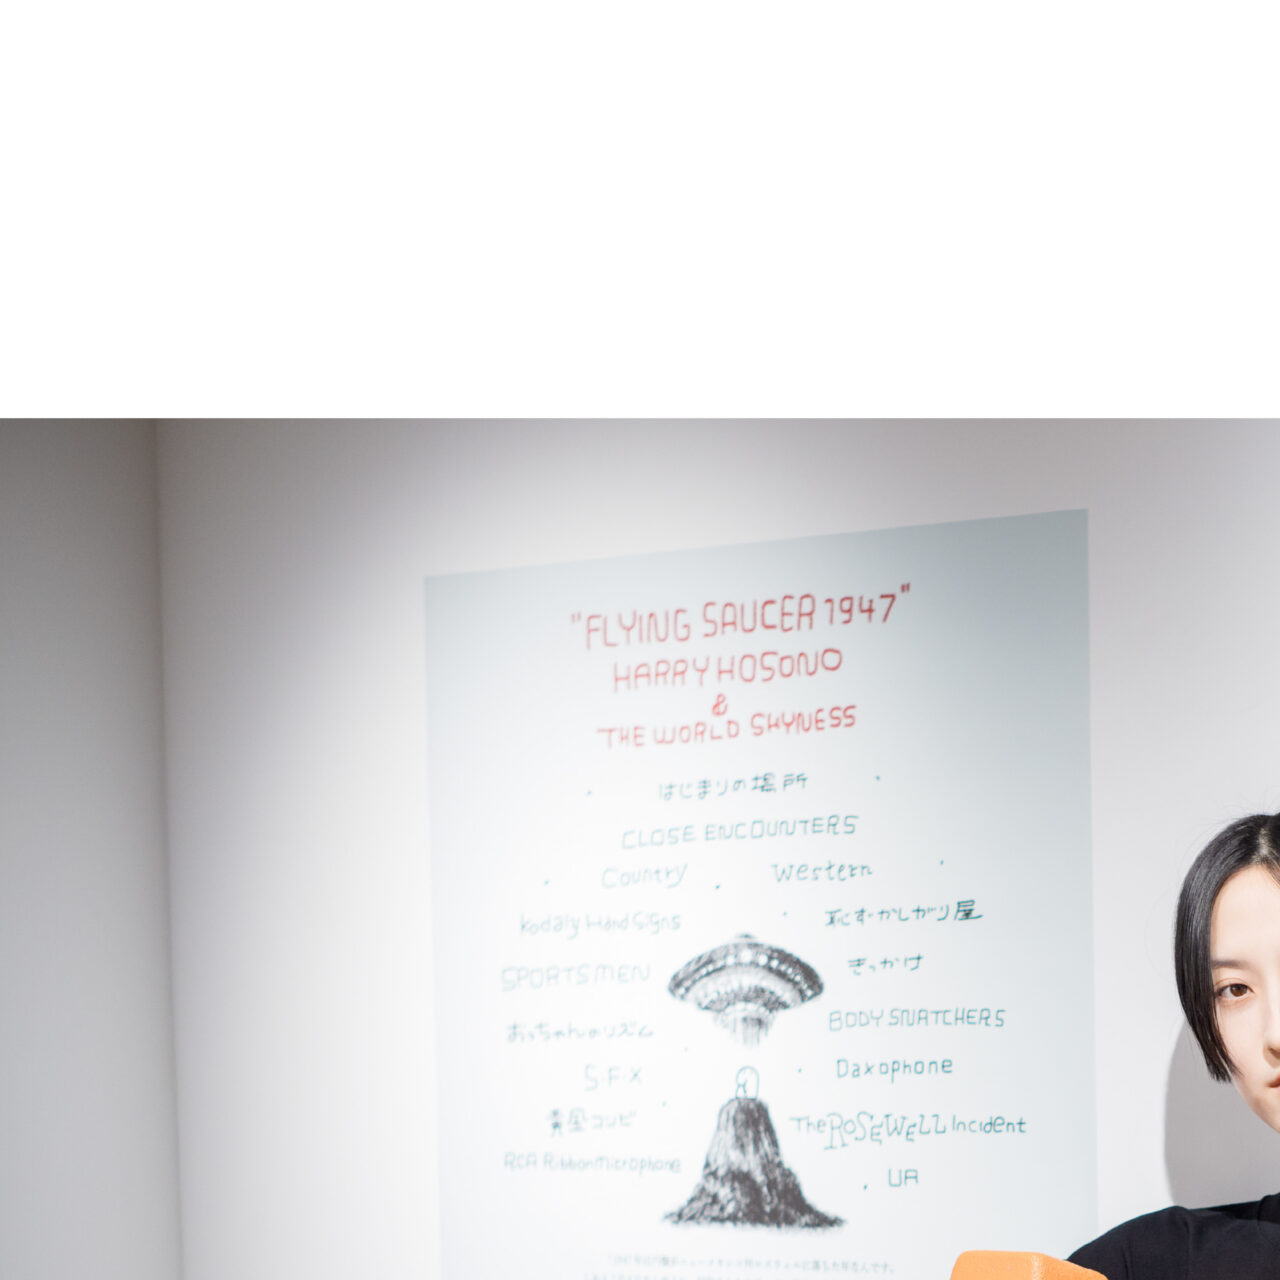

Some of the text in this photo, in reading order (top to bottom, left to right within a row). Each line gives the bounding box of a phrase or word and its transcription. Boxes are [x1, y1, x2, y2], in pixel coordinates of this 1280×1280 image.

[703, 594, 815, 638] SAUCER
[614, 656, 710, 692] HARRY
[712, 693, 728, 716] &
[597, 705, 857, 749] THE WORLD SHYNESS
[659, 772, 808, 800] はじまりの場所
[622, 814, 859, 851] CLOSE ENCOUNTERS
[601, 863, 688, 889] Country
[825, 900, 983, 927] 恥ずかしがり屋
[848, 953, 924, 975] きっかけ
[829, 1007, 1006, 1032] BODY SNATCHERS
[836, 1058, 953, 1084] Daxophone
[789, 1114, 826, 1134] The
[952, 1114, 1027, 1134] Incident
[888, 1168, 919, 1187] UA
